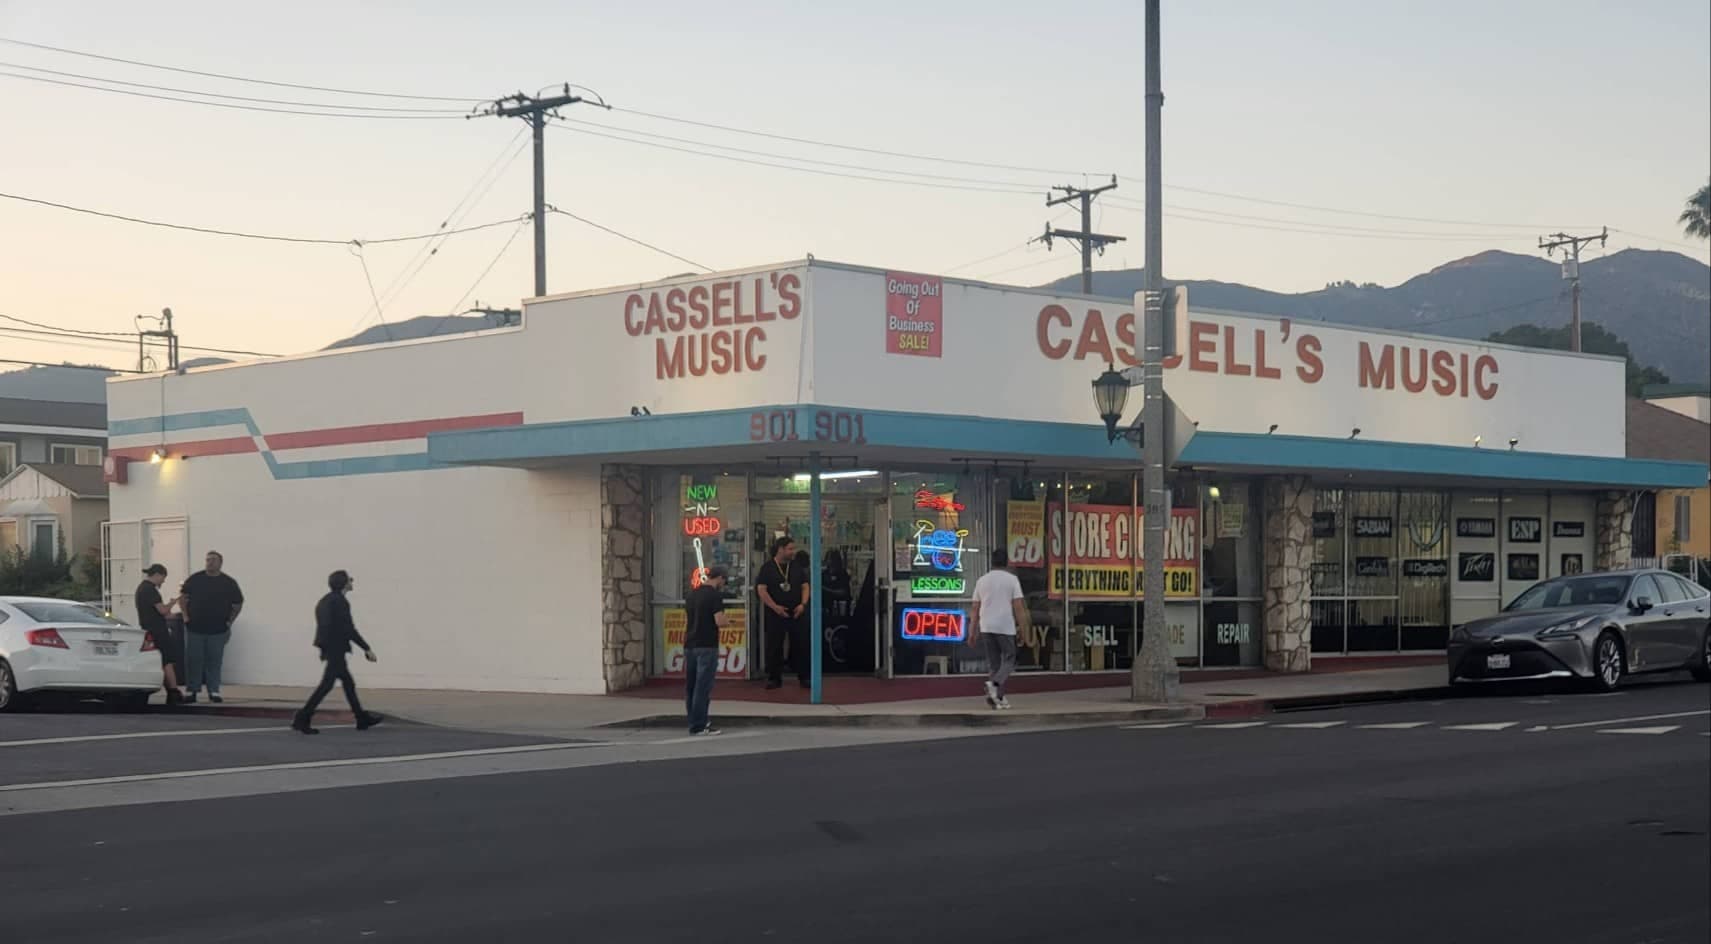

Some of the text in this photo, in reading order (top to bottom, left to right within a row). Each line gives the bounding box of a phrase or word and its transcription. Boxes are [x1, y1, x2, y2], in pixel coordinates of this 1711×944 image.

[888, 279, 939, 299] Going Out
[624, 271, 801, 337] CASSELL'S
[906, 300, 920, 315] Of
[889, 315, 935, 333] Business
[899, 334, 929, 351] SALE!
[656, 326, 767, 380] MUSIC
[1359, 341, 1500, 400] MUSIC
[750, 409, 798, 442] 901
[816, 411, 867, 444] 901
[687, 485, 717, 499] NEW
[685, 517, 721, 535] USED
[1011, 521, 1041, 537] MUST
[1356, 519, 1391, 534] SABIAN
[1511, 520, 1540, 539] ESP
[1008, 537, 1041, 564] GO
[911, 578, 963, 591] LESSONS
[1171, 571, 1193, 593] GO!
[904, 611, 962, 637] OPEN
[1217, 623, 1251, 645] REPAIR
[1084, 625, 1119, 646] SELL
